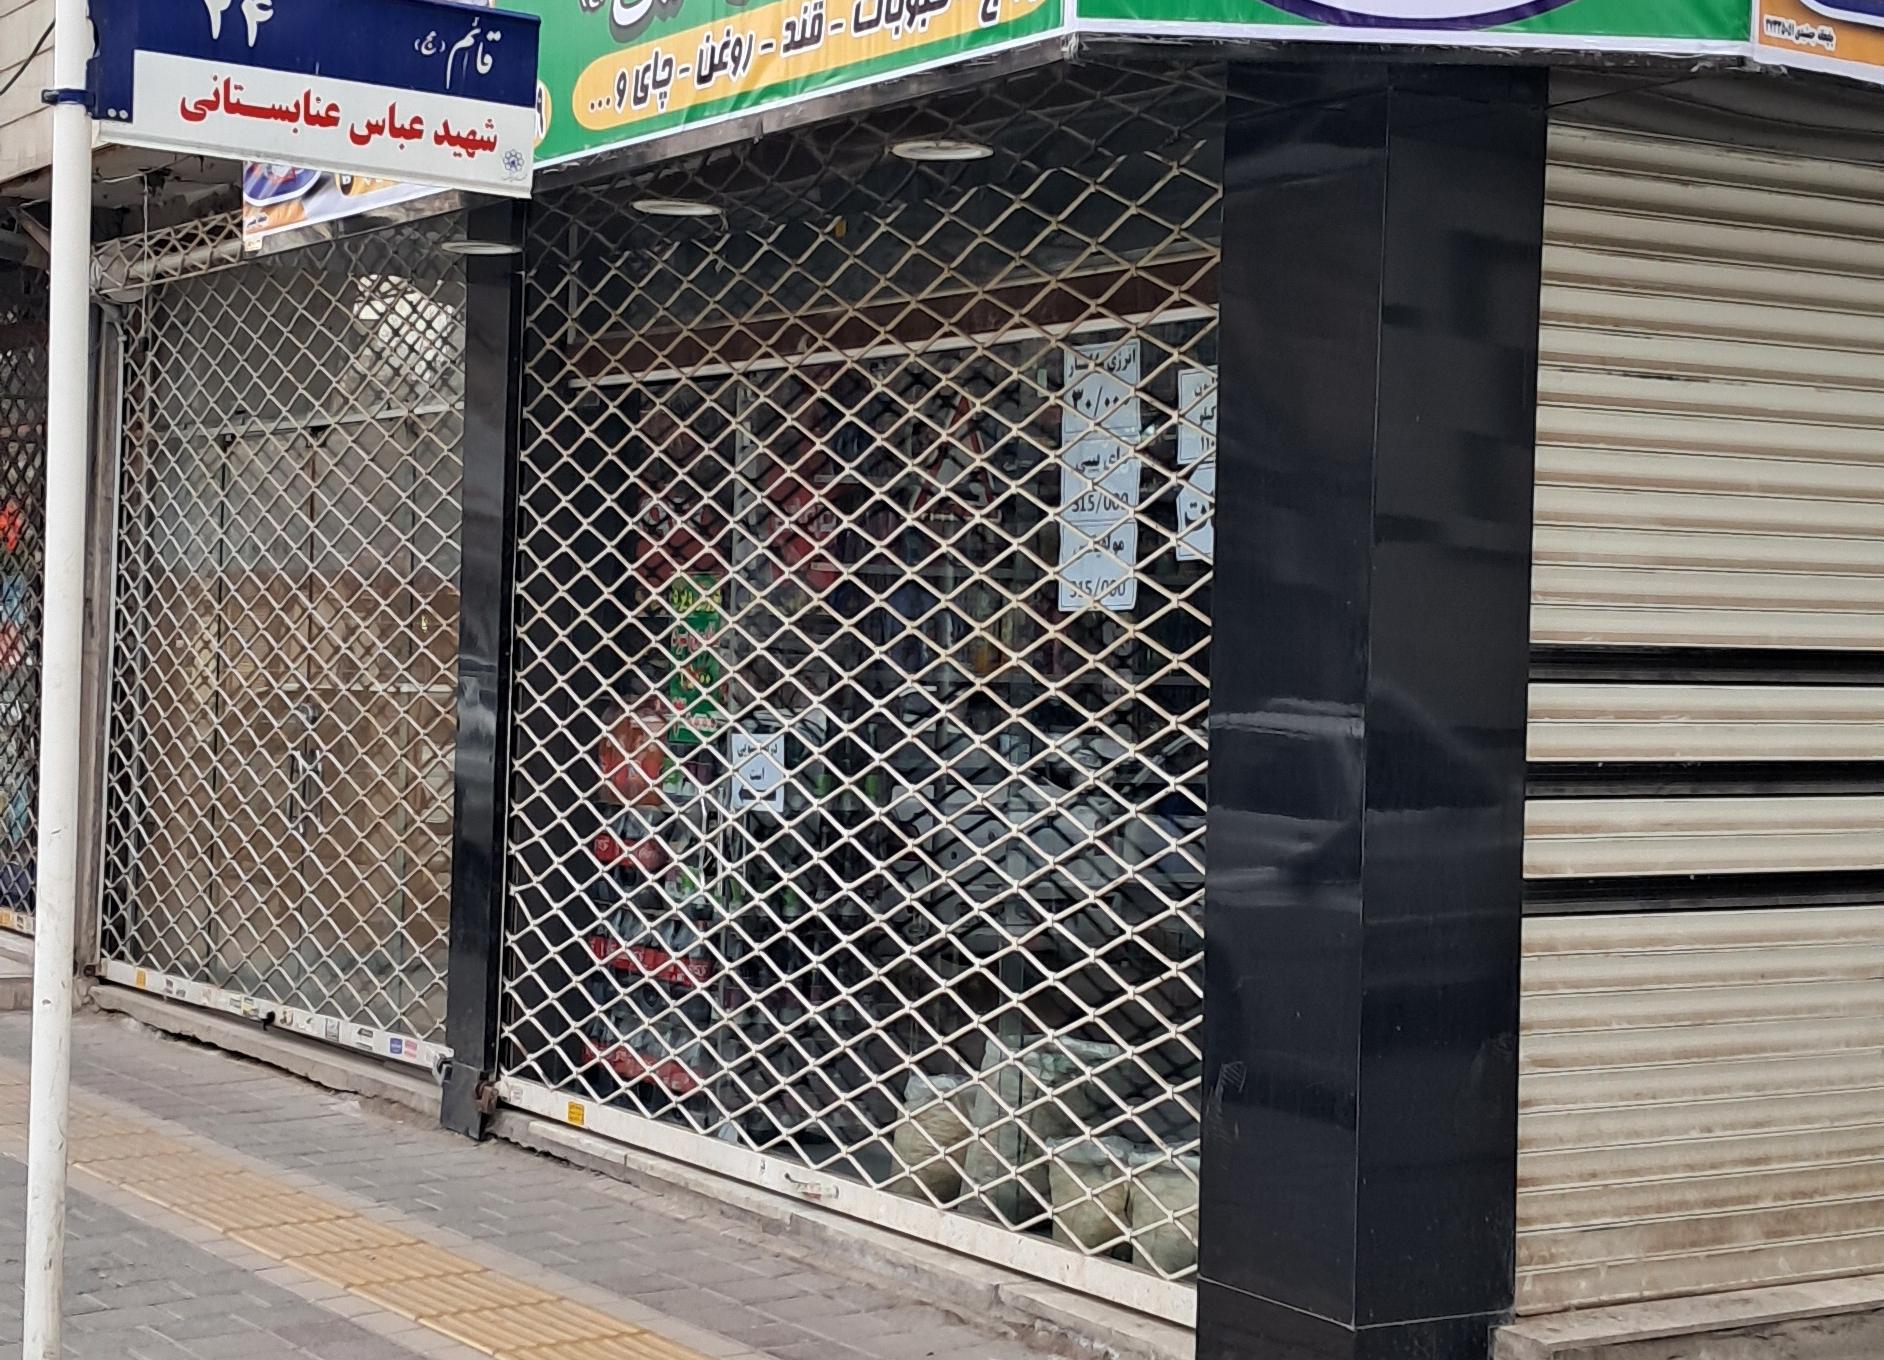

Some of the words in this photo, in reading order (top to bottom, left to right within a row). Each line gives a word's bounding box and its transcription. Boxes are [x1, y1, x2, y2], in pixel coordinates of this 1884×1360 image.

[446, 16, 502, 90] قائم
[697, 26, 753, 84] روغن
[783, 0, 824, 52] قند
[180, 73, 341, 136] عنابستانی
[633, 51, 673, 110] چای
[349, 102, 424, 150] عباس
[433, 118, 498, 159] شهید
